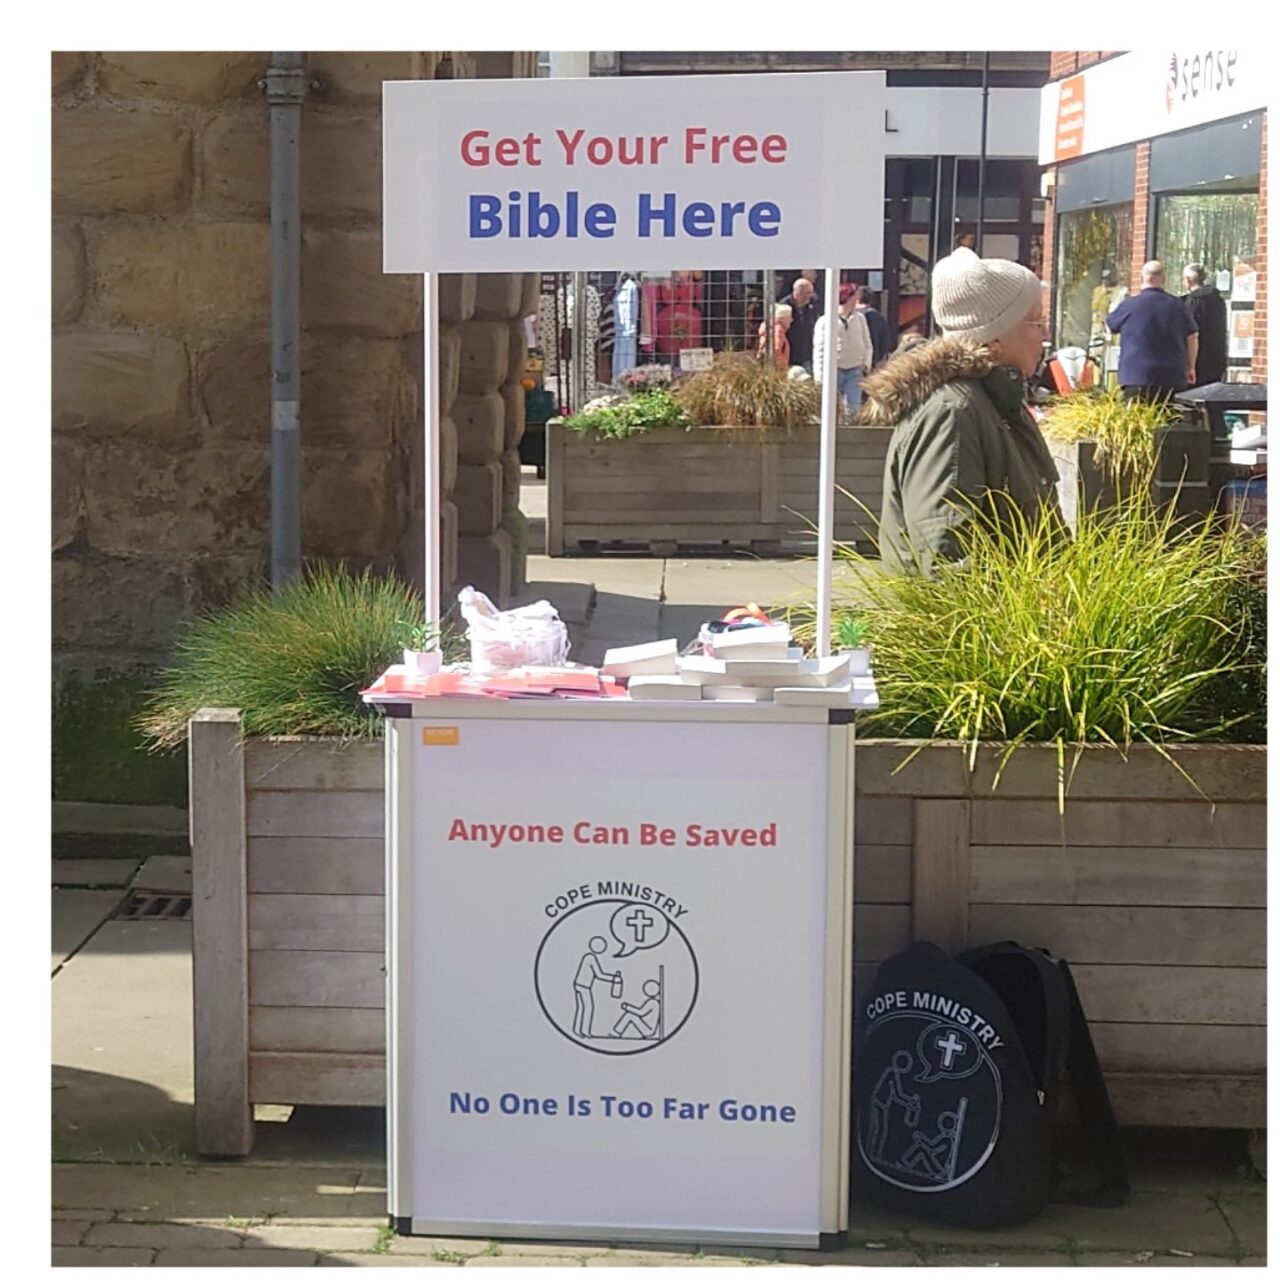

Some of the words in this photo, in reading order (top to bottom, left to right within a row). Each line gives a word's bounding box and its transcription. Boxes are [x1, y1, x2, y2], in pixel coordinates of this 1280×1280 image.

[1181, 49, 1238, 101] sense
[460, 130, 541, 167] Get
[556, 129, 667, 165] Your
[685, 127, 787, 164] Free
[468, 191, 617, 239] Bible
[638, 193, 782, 238] Here
[448, 818, 565, 848] Anyone
[573, 821, 630, 845] Can
[640, 823, 677, 847] Be
[685, 823, 778, 848] Saved
[544, 884, 593, 919] COPE
[597, 881, 689, 919] MINISTRY
[866, 991, 908, 1020] COPE
[913, 991, 1004, 1050] MINISTRY
[450, 1092, 490, 1114] No
[499, 1092, 559, 1116] One
[568, 1094, 592, 1116] Is
[600, 1096, 654, 1119] Too
[663, 1097, 710, 1120] Far
[719, 1099, 797, 1123] Gone
